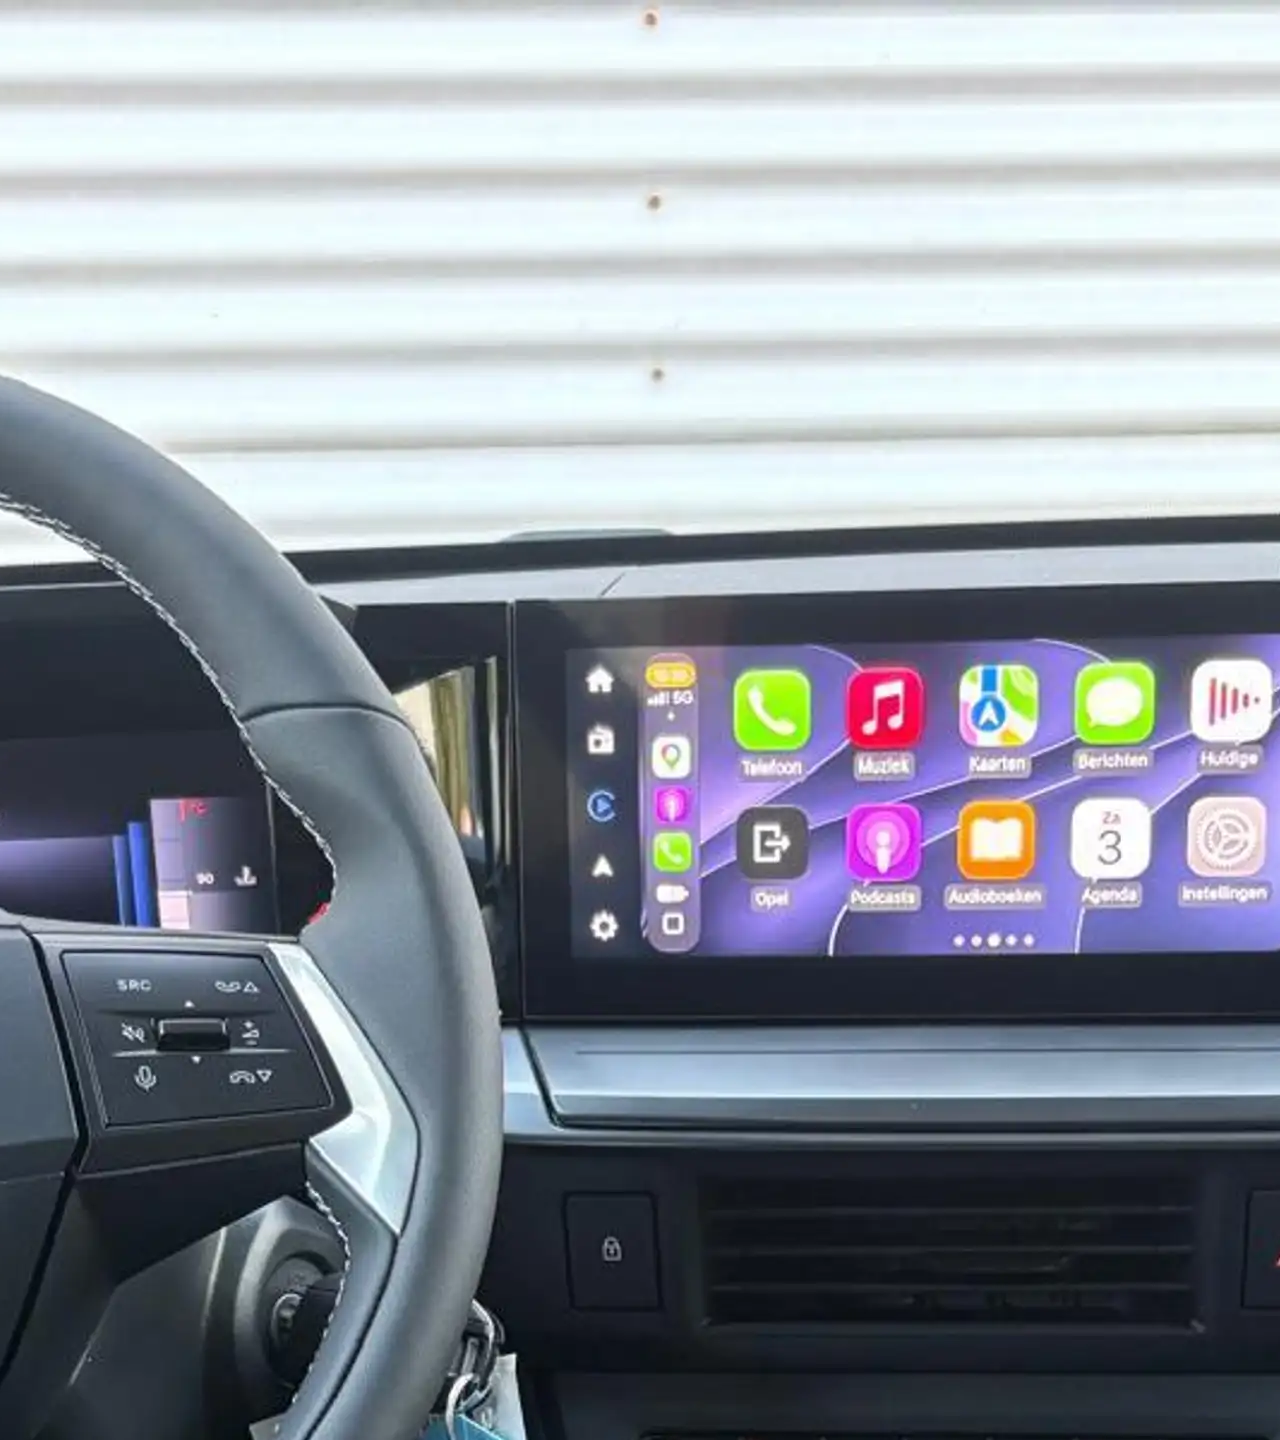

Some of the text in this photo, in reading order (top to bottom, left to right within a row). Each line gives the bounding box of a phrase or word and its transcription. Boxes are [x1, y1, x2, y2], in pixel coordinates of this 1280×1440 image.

[742, 761, 802, 774] Telefoon
[858, 758, 910, 774] Muziek
[970, 756, 1026, 772] Kaarten
[1079, 754, 1148, 770] Berichten
[1201, 751, 1258, 768] Huidige
[1098, 830, 1122, 865] 3
[755, 891, 789, 907] Opel
[851, 890, 915, 904] Podcasts
[949, 888, 1042, 904] Audioboeken
[1082, 886, 1137, 903] Agenda
[1182, 885, 1267, 901] Instellingen
[117, 979, 152, 991] SRC
